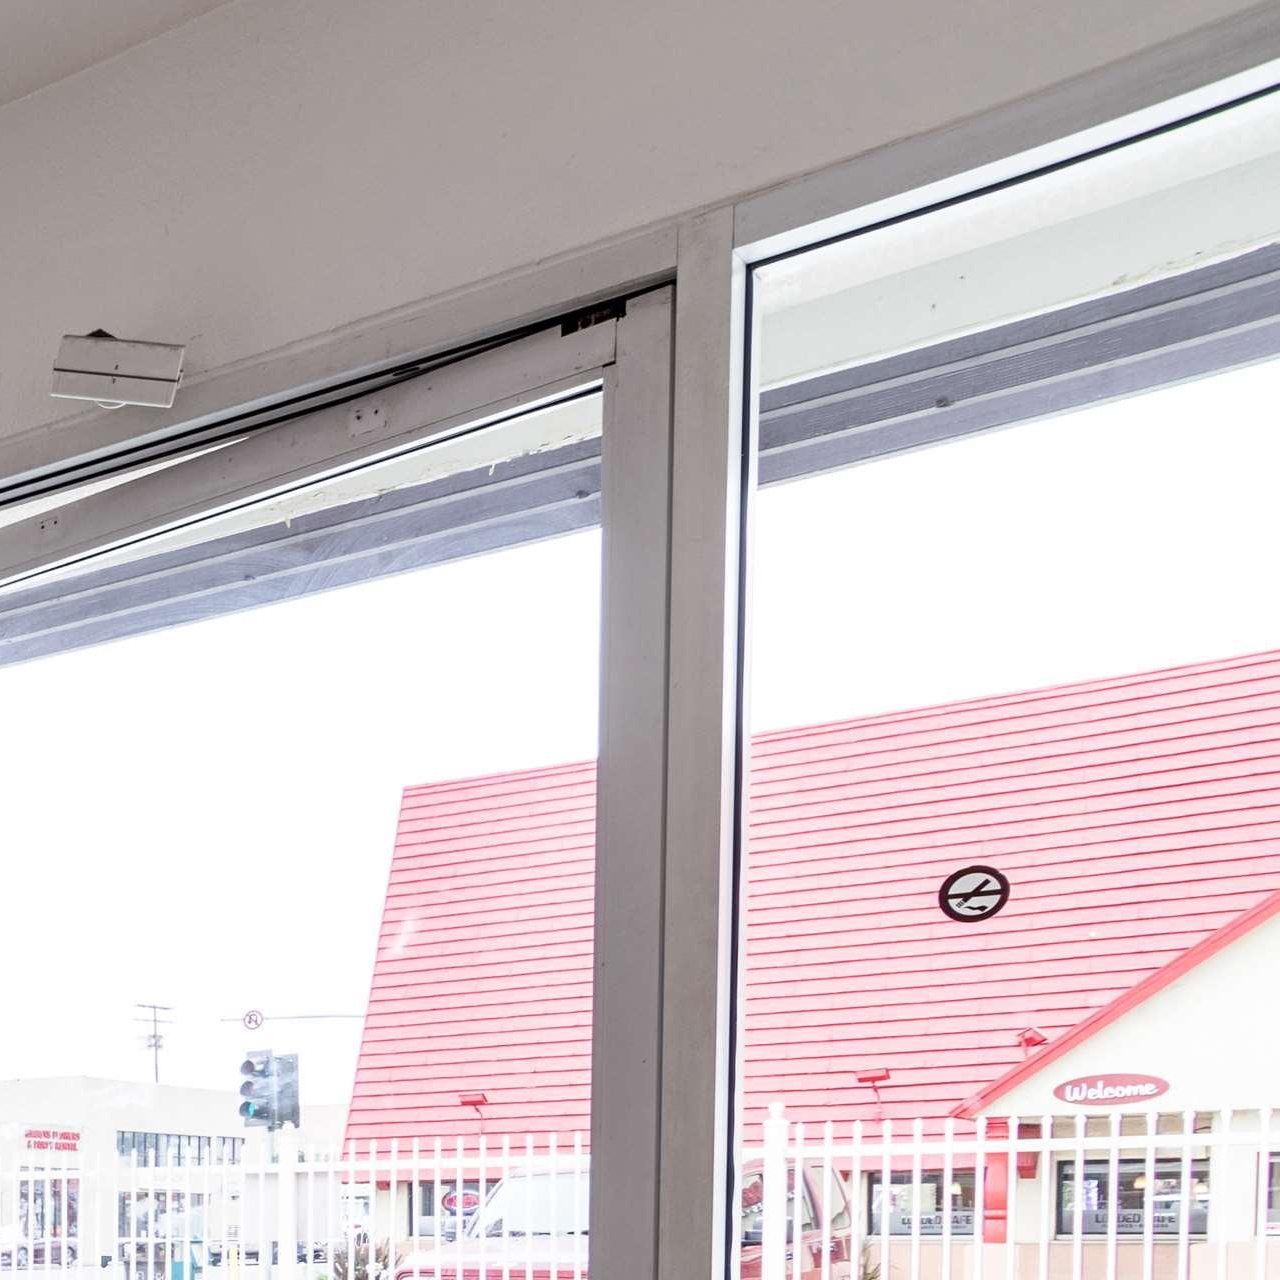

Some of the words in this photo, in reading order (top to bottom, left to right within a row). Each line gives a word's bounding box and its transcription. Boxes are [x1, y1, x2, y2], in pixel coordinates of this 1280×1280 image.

[1064, 1079, 1160, 1101] Welcome
[946, 1215, 973, 1225] AFE
[1147, 1213, 1176, 1223] AFE
